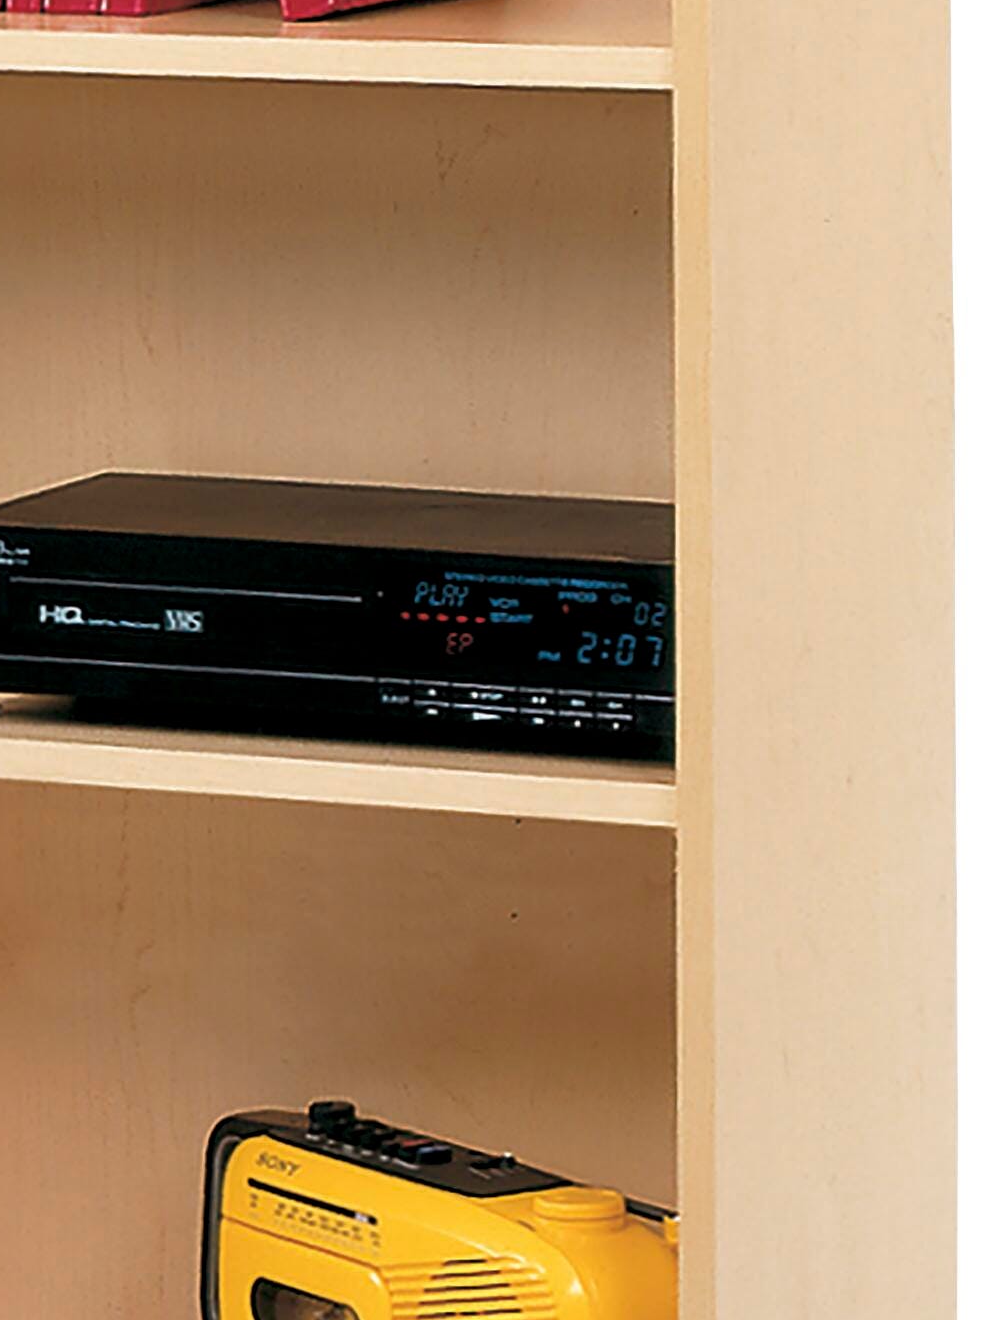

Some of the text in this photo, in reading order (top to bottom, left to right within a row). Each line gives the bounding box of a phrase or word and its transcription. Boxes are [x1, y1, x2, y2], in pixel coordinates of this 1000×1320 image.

[414, 582, 470, 607] PLAY
[39, 605, 84, 624] HQ
[633, 602, 667, 627] 02
[446, 633, 474, 655] EP
[577, 631, 663, 667] 2:07
[256, 1151, 300, 1177] SONY
